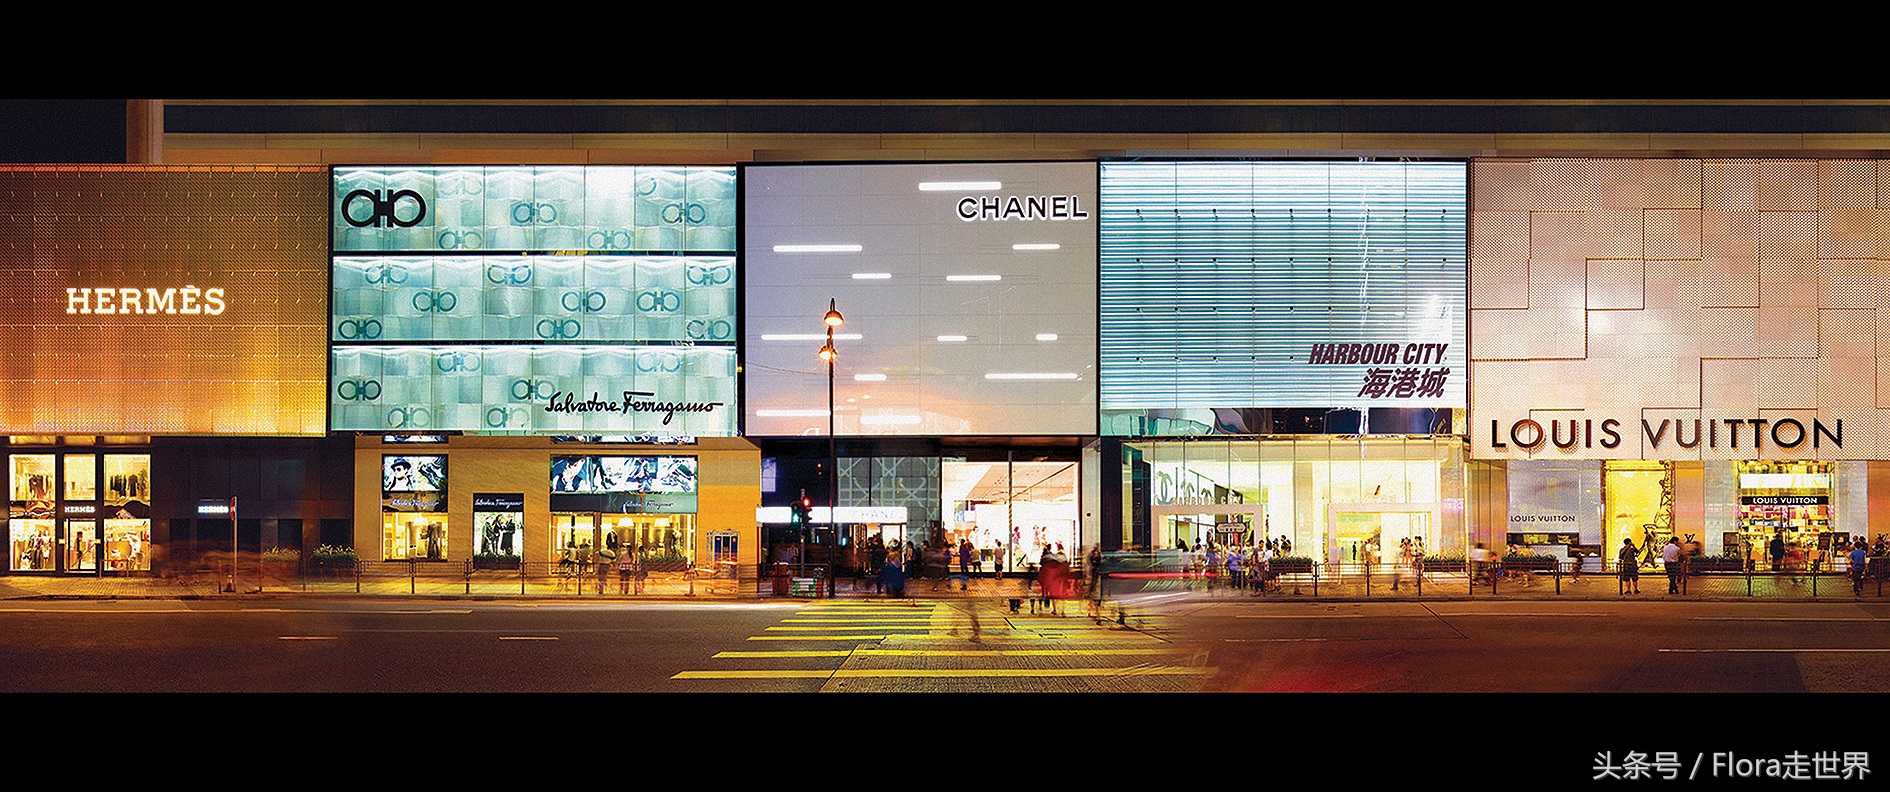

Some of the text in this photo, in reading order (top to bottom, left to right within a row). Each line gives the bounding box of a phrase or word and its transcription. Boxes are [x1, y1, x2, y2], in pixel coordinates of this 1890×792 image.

[958, 196, 1088, 219] CHANEL
[65, 285, 226, 316] HERMÈS
[1308, 343, 1449, 364] HARBOUR CITY
[1356, 367, 1451, 399] 海港城
[545, 391, 724, 425] Salvatore Ferragamo
[1491, 418, 1844, 449] LOUIS VUITTON
